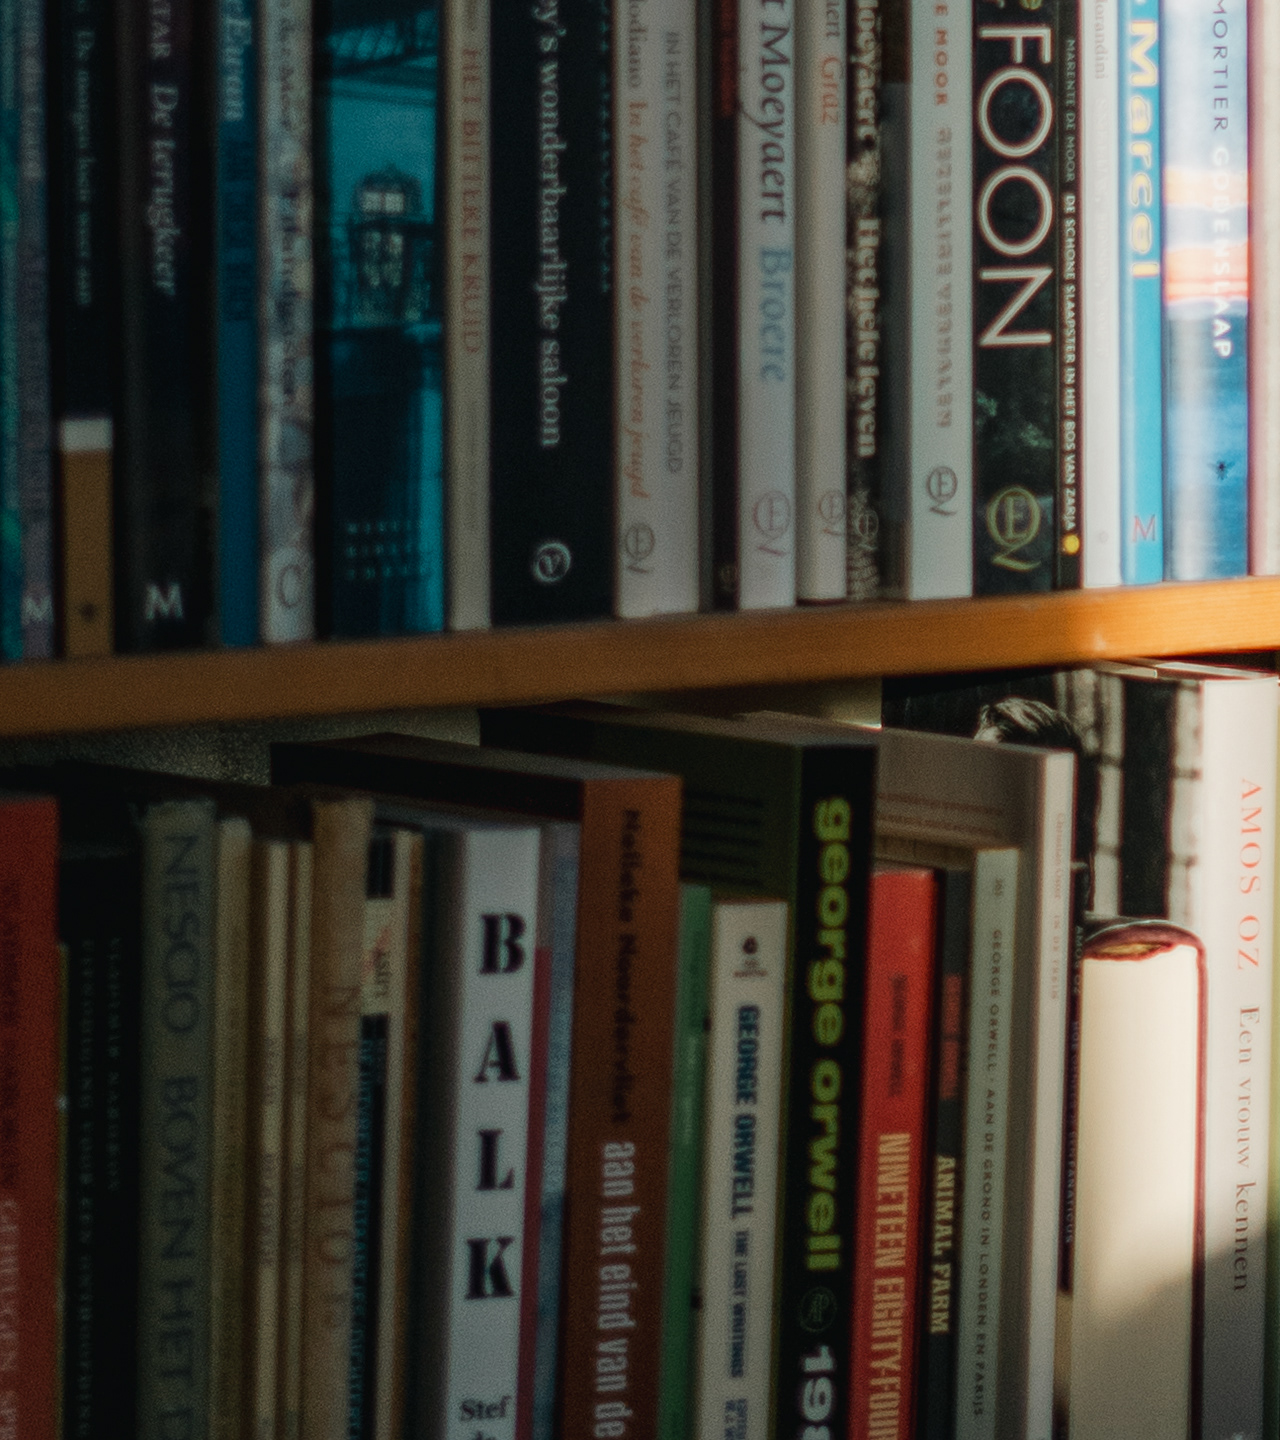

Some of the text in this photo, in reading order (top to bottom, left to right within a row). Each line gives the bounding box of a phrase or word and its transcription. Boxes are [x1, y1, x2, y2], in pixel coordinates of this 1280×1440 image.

[737, 19, 792, 224] Moeyaert
[978, 23, 1054, 348] FOON
[1128, 20, 1160, 278] Marcel
[758, 246, 790, 384] Broere
[811, 798, 850, 1045] george
[465, 913, 525, 1302] BALK
[806, 1062, 845, 1272] orwell
[874, 1131, 911, 1270] NINETEEN
[459, 1396, 511, 1423] Stef
